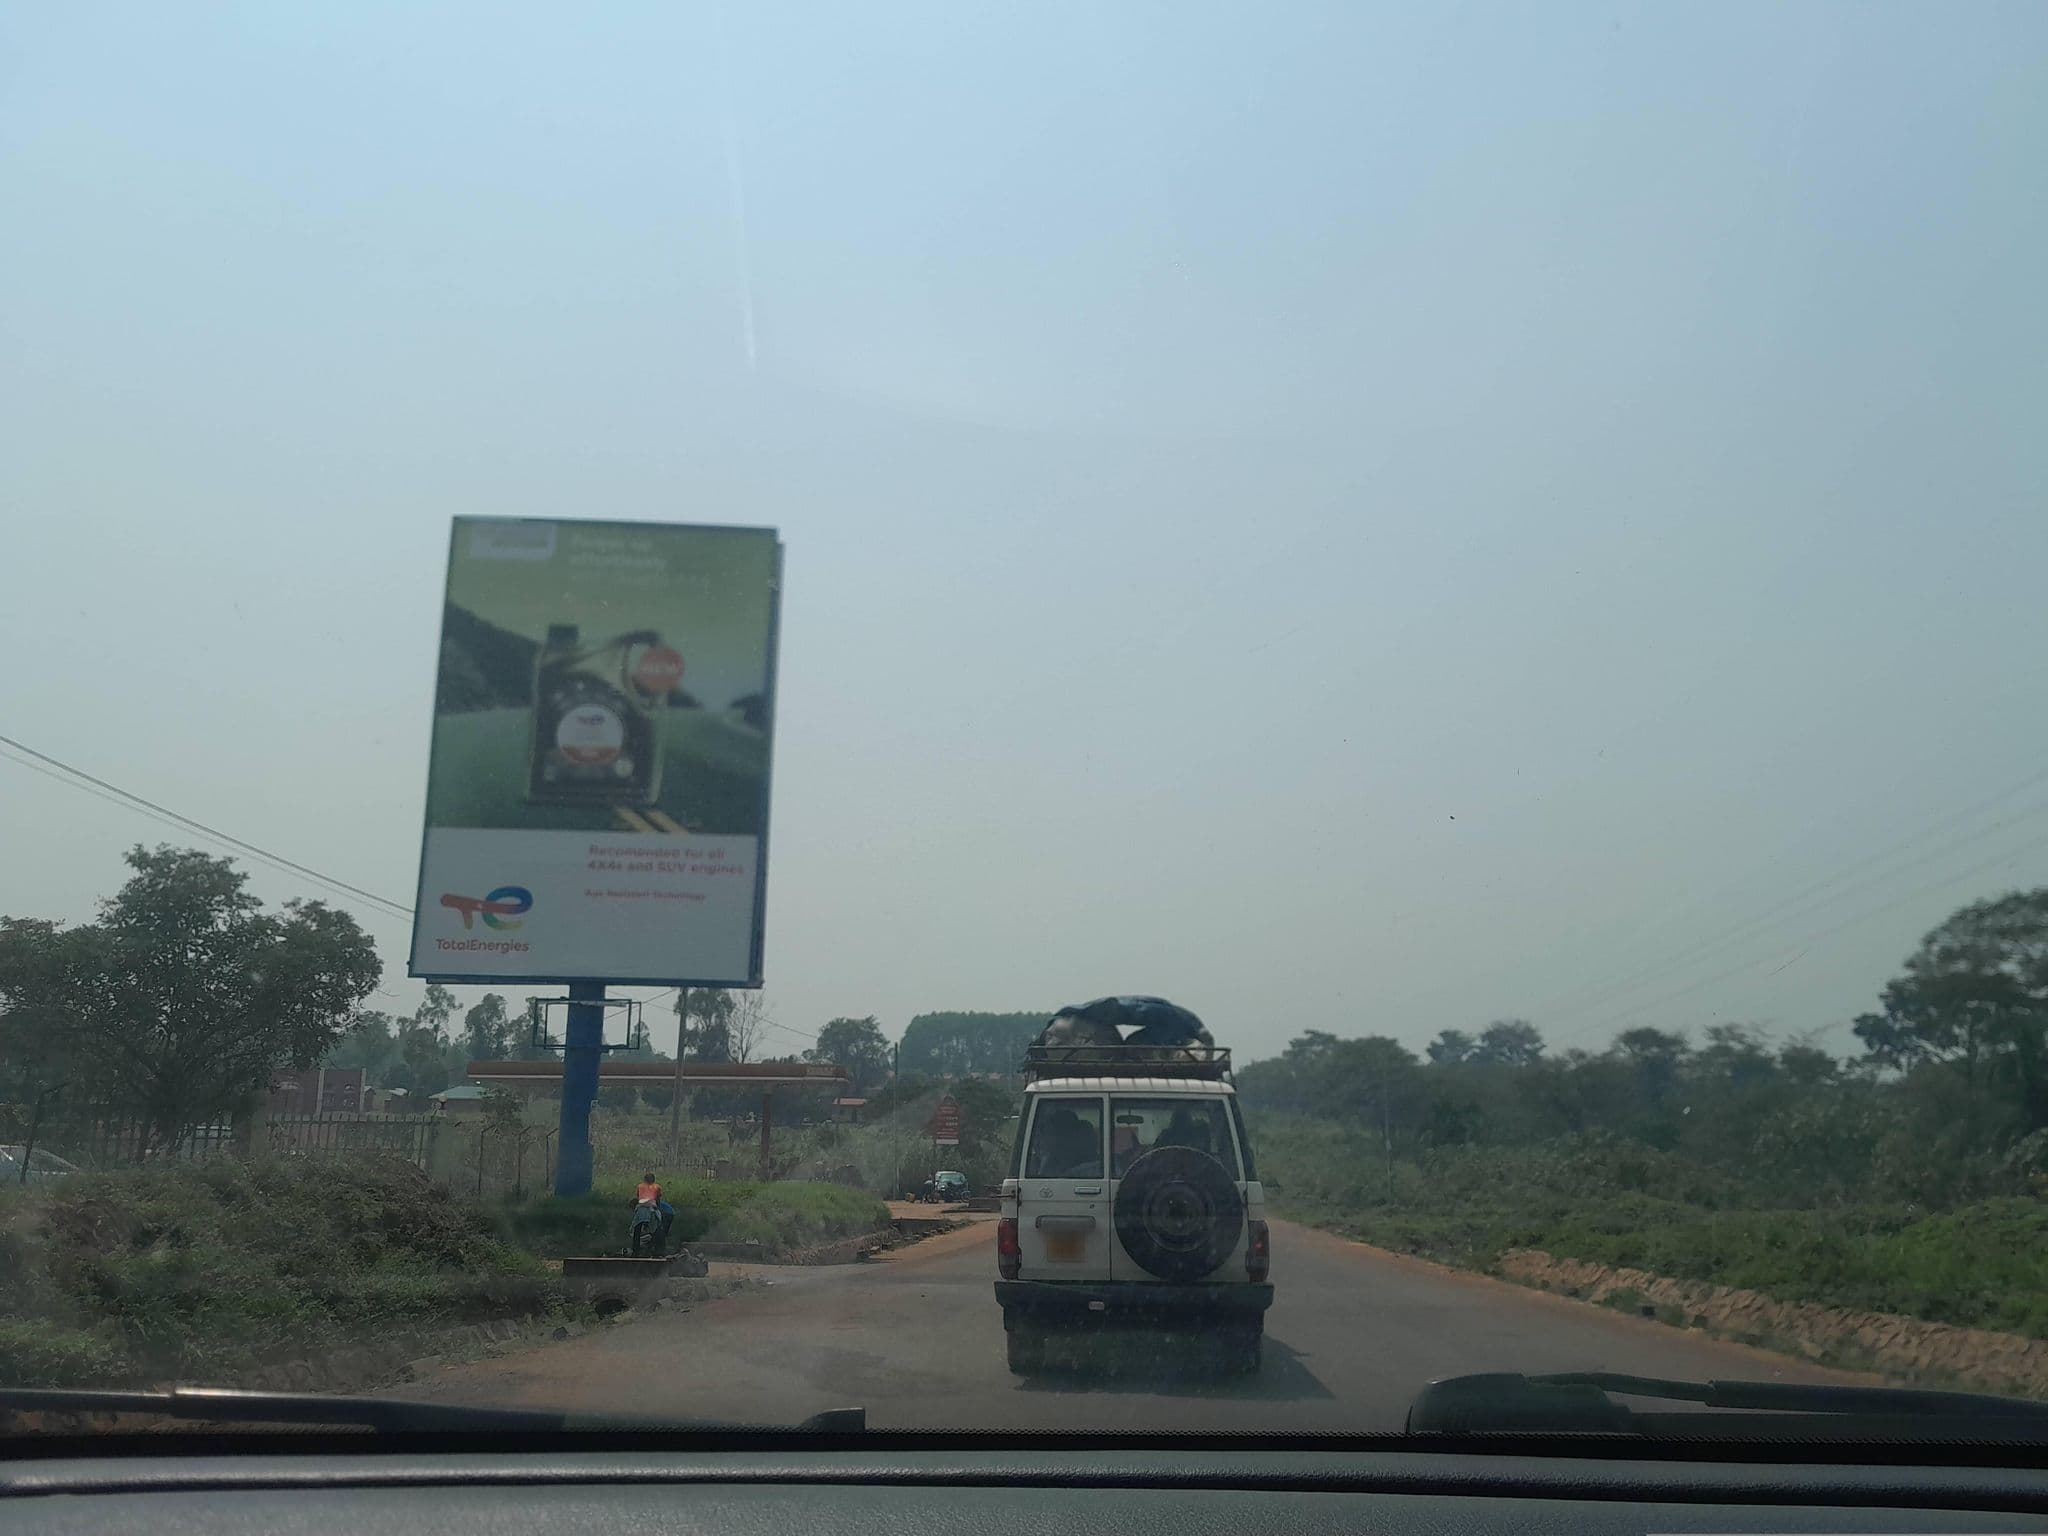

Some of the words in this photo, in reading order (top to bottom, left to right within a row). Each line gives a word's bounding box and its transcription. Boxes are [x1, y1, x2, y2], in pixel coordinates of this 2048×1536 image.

[627, 860, 653, 872] and
[657, 861, 688, 873] SUV
[691, 862, 745, 876] engines
[435, 938, 529, 953] TotalEnergies
